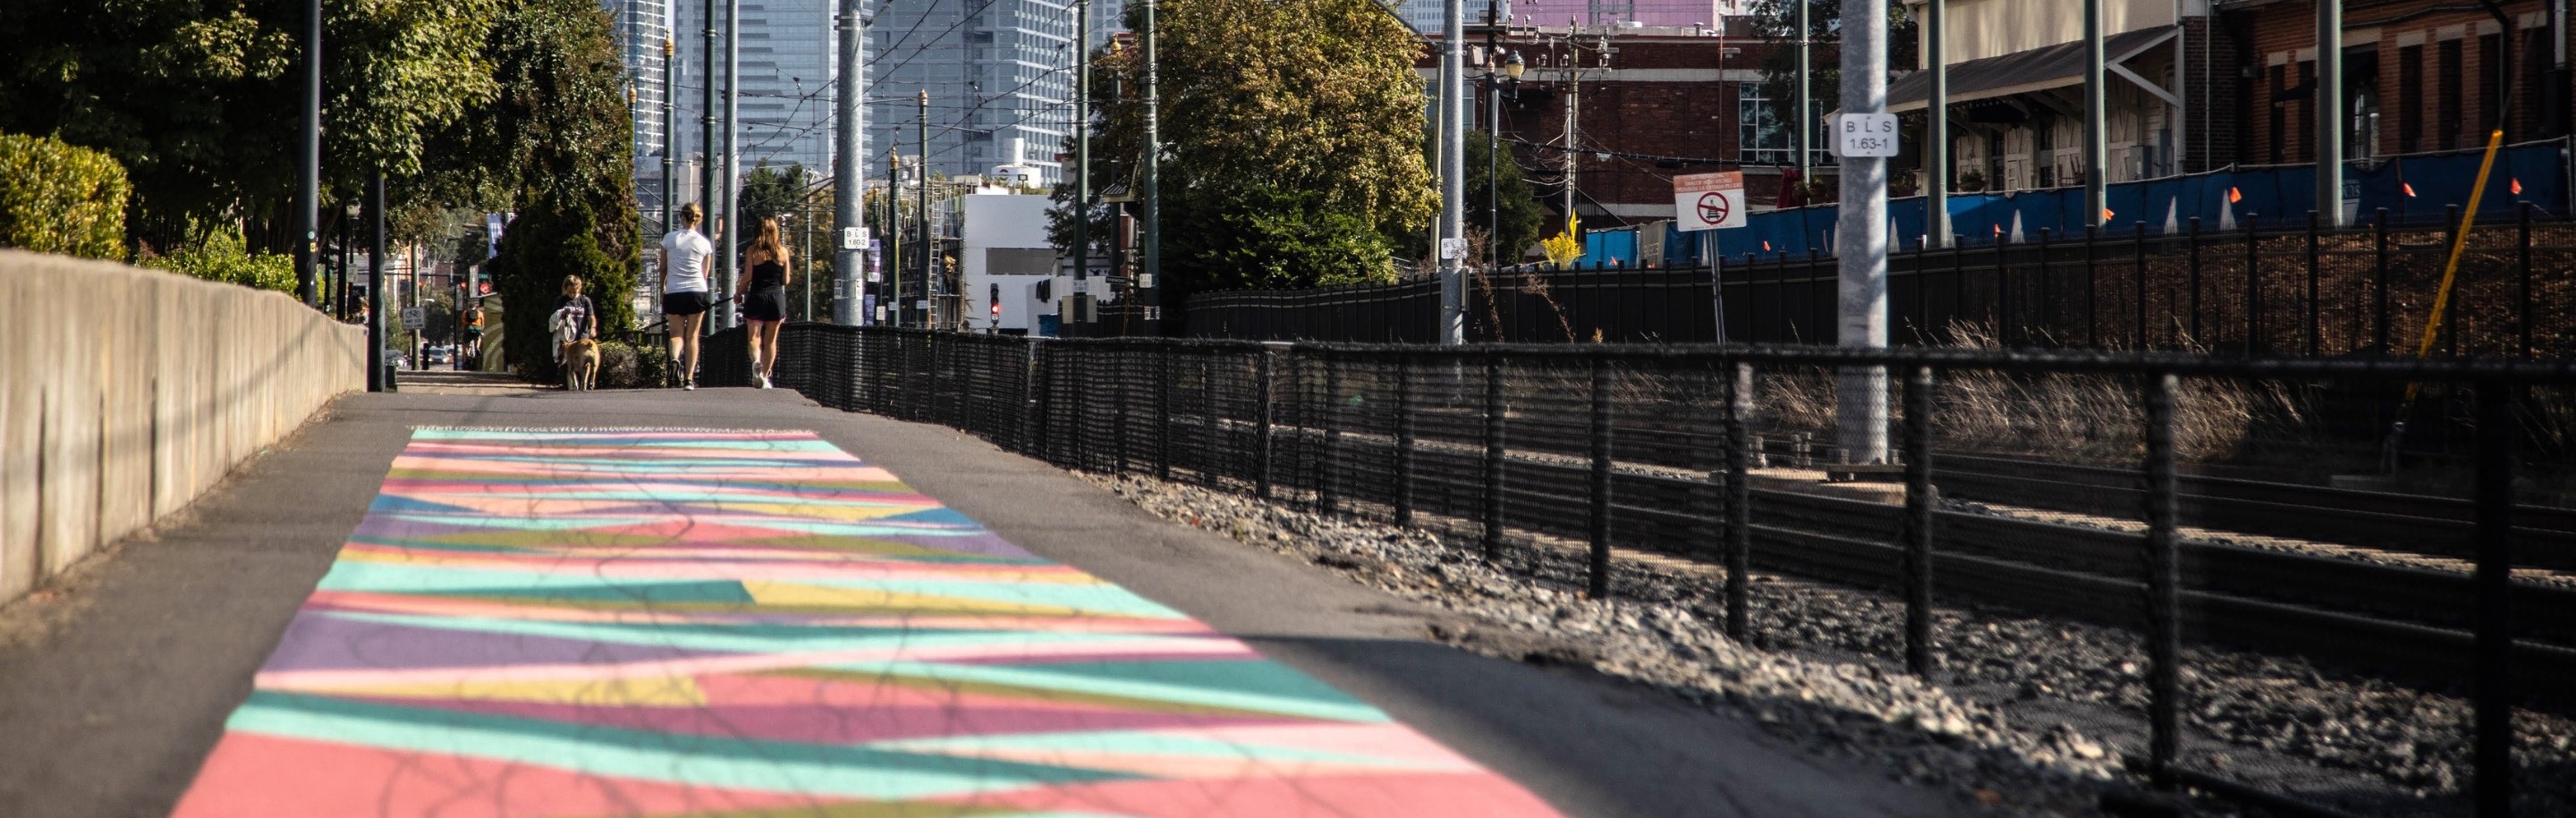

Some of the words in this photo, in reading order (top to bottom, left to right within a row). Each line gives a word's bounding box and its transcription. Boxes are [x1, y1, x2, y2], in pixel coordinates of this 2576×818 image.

[1846, 121, 1855, 132] B
[1865, 121, 1873, 132] L
[1883, 121, 1892, 132] S
[1850, 138, 1888, 149] 1.63-1
